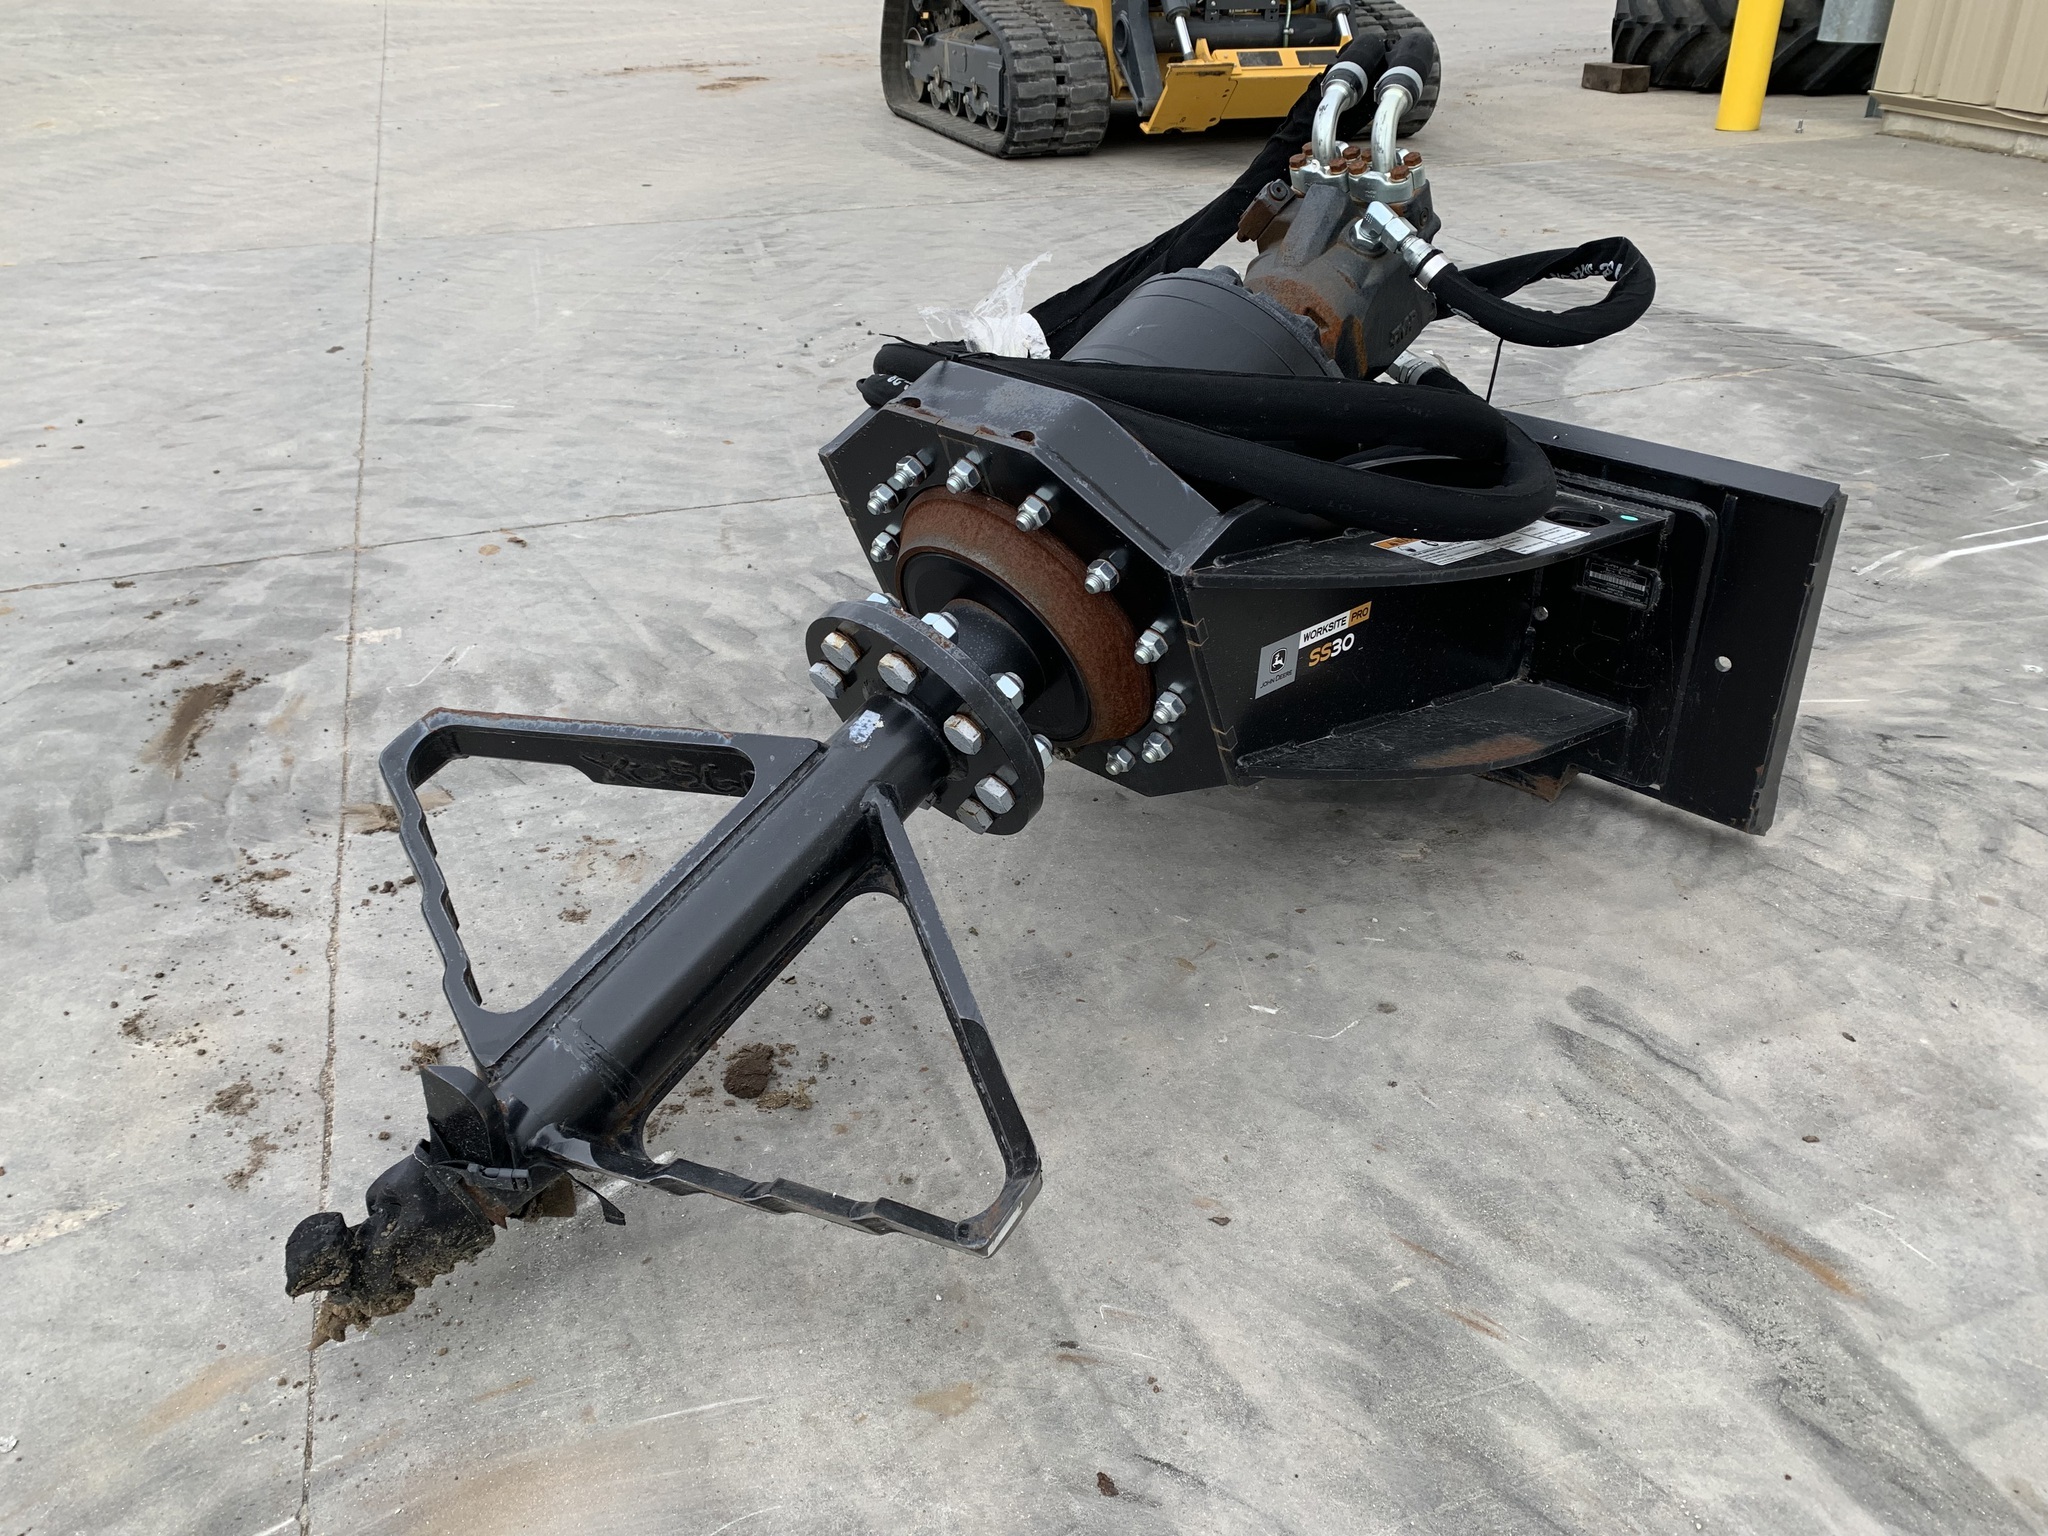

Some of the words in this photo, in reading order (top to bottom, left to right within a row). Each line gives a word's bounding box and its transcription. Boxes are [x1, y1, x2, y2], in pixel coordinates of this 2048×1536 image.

[1303, 616, 1347, 642] WORKSITE
[1351, 607, 1369, 622] PRO
[1309, 633, 1355, 667] SS30
[1260, 678, 1275, 689] JOHN
[1276, 669, 1293, 682] DEERE
